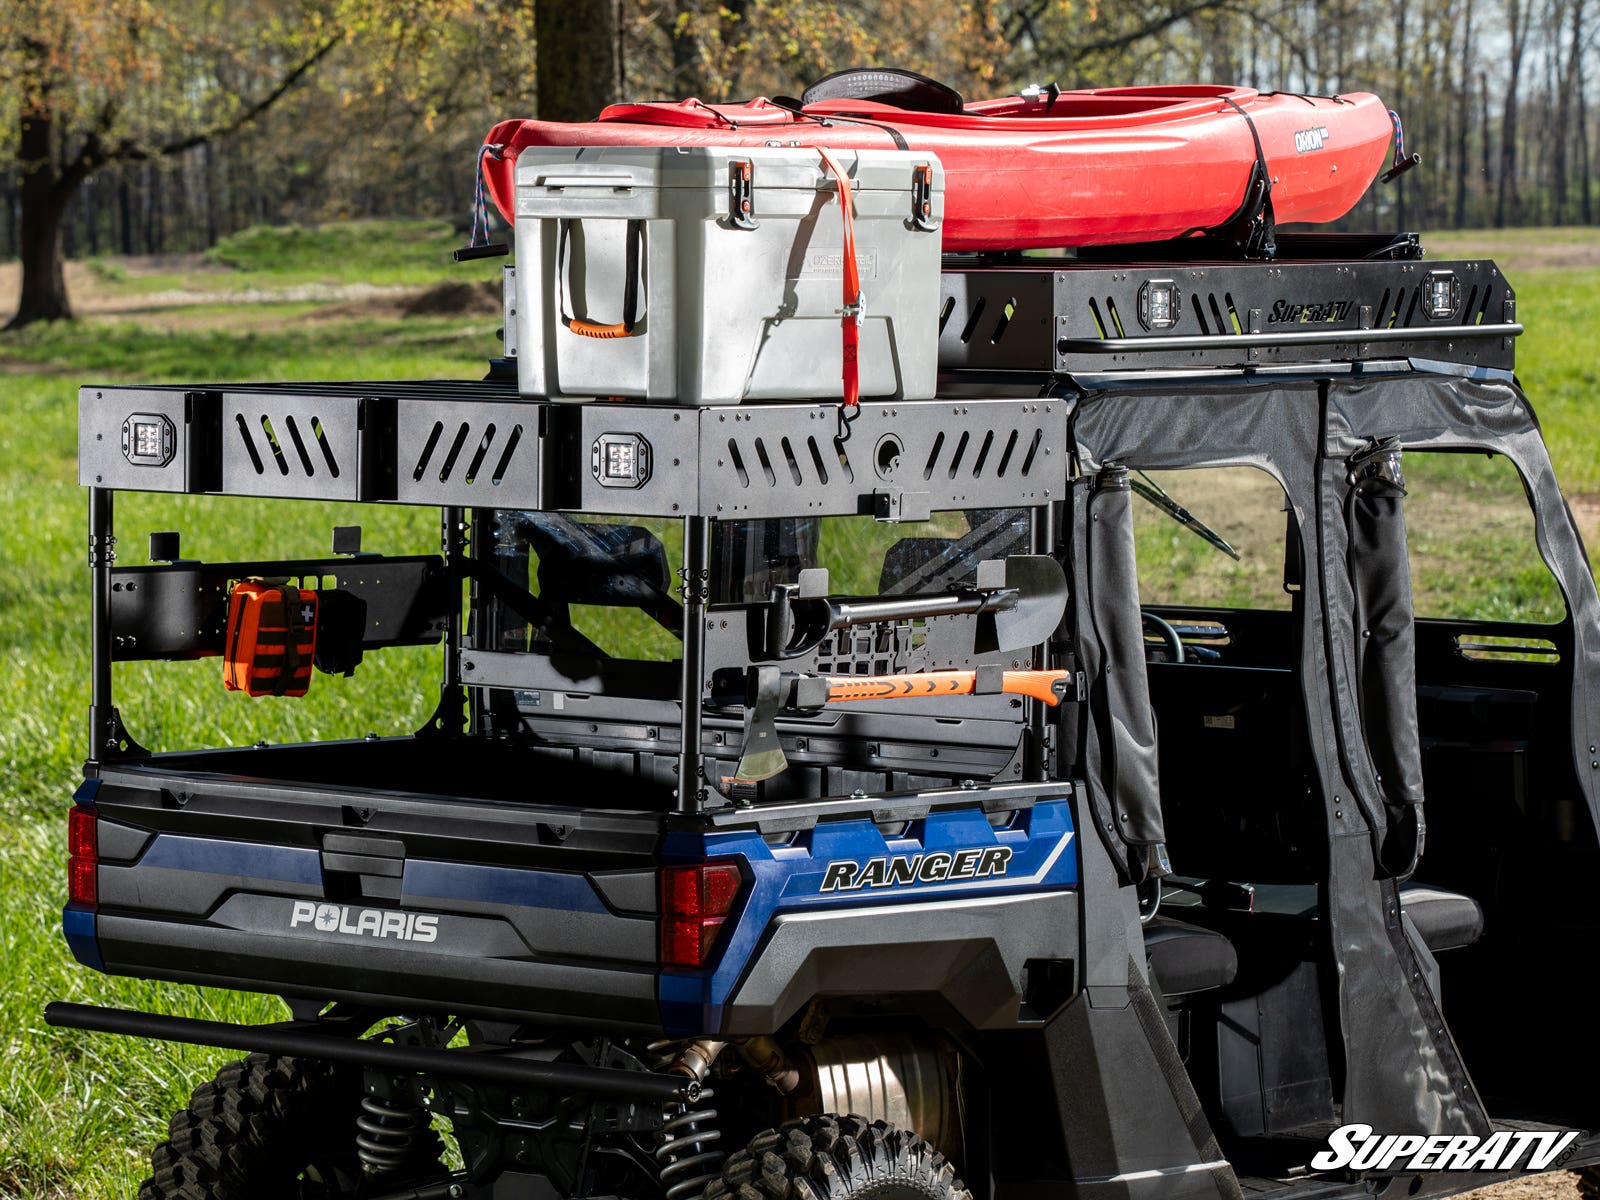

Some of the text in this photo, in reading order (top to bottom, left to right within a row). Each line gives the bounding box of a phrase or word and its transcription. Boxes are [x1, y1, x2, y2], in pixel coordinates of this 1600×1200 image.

[1294, 128, 1323, 153] ORION
[819, 846, 1013, 893] RANGER
[290, 901, 439, 943] POLARIS
